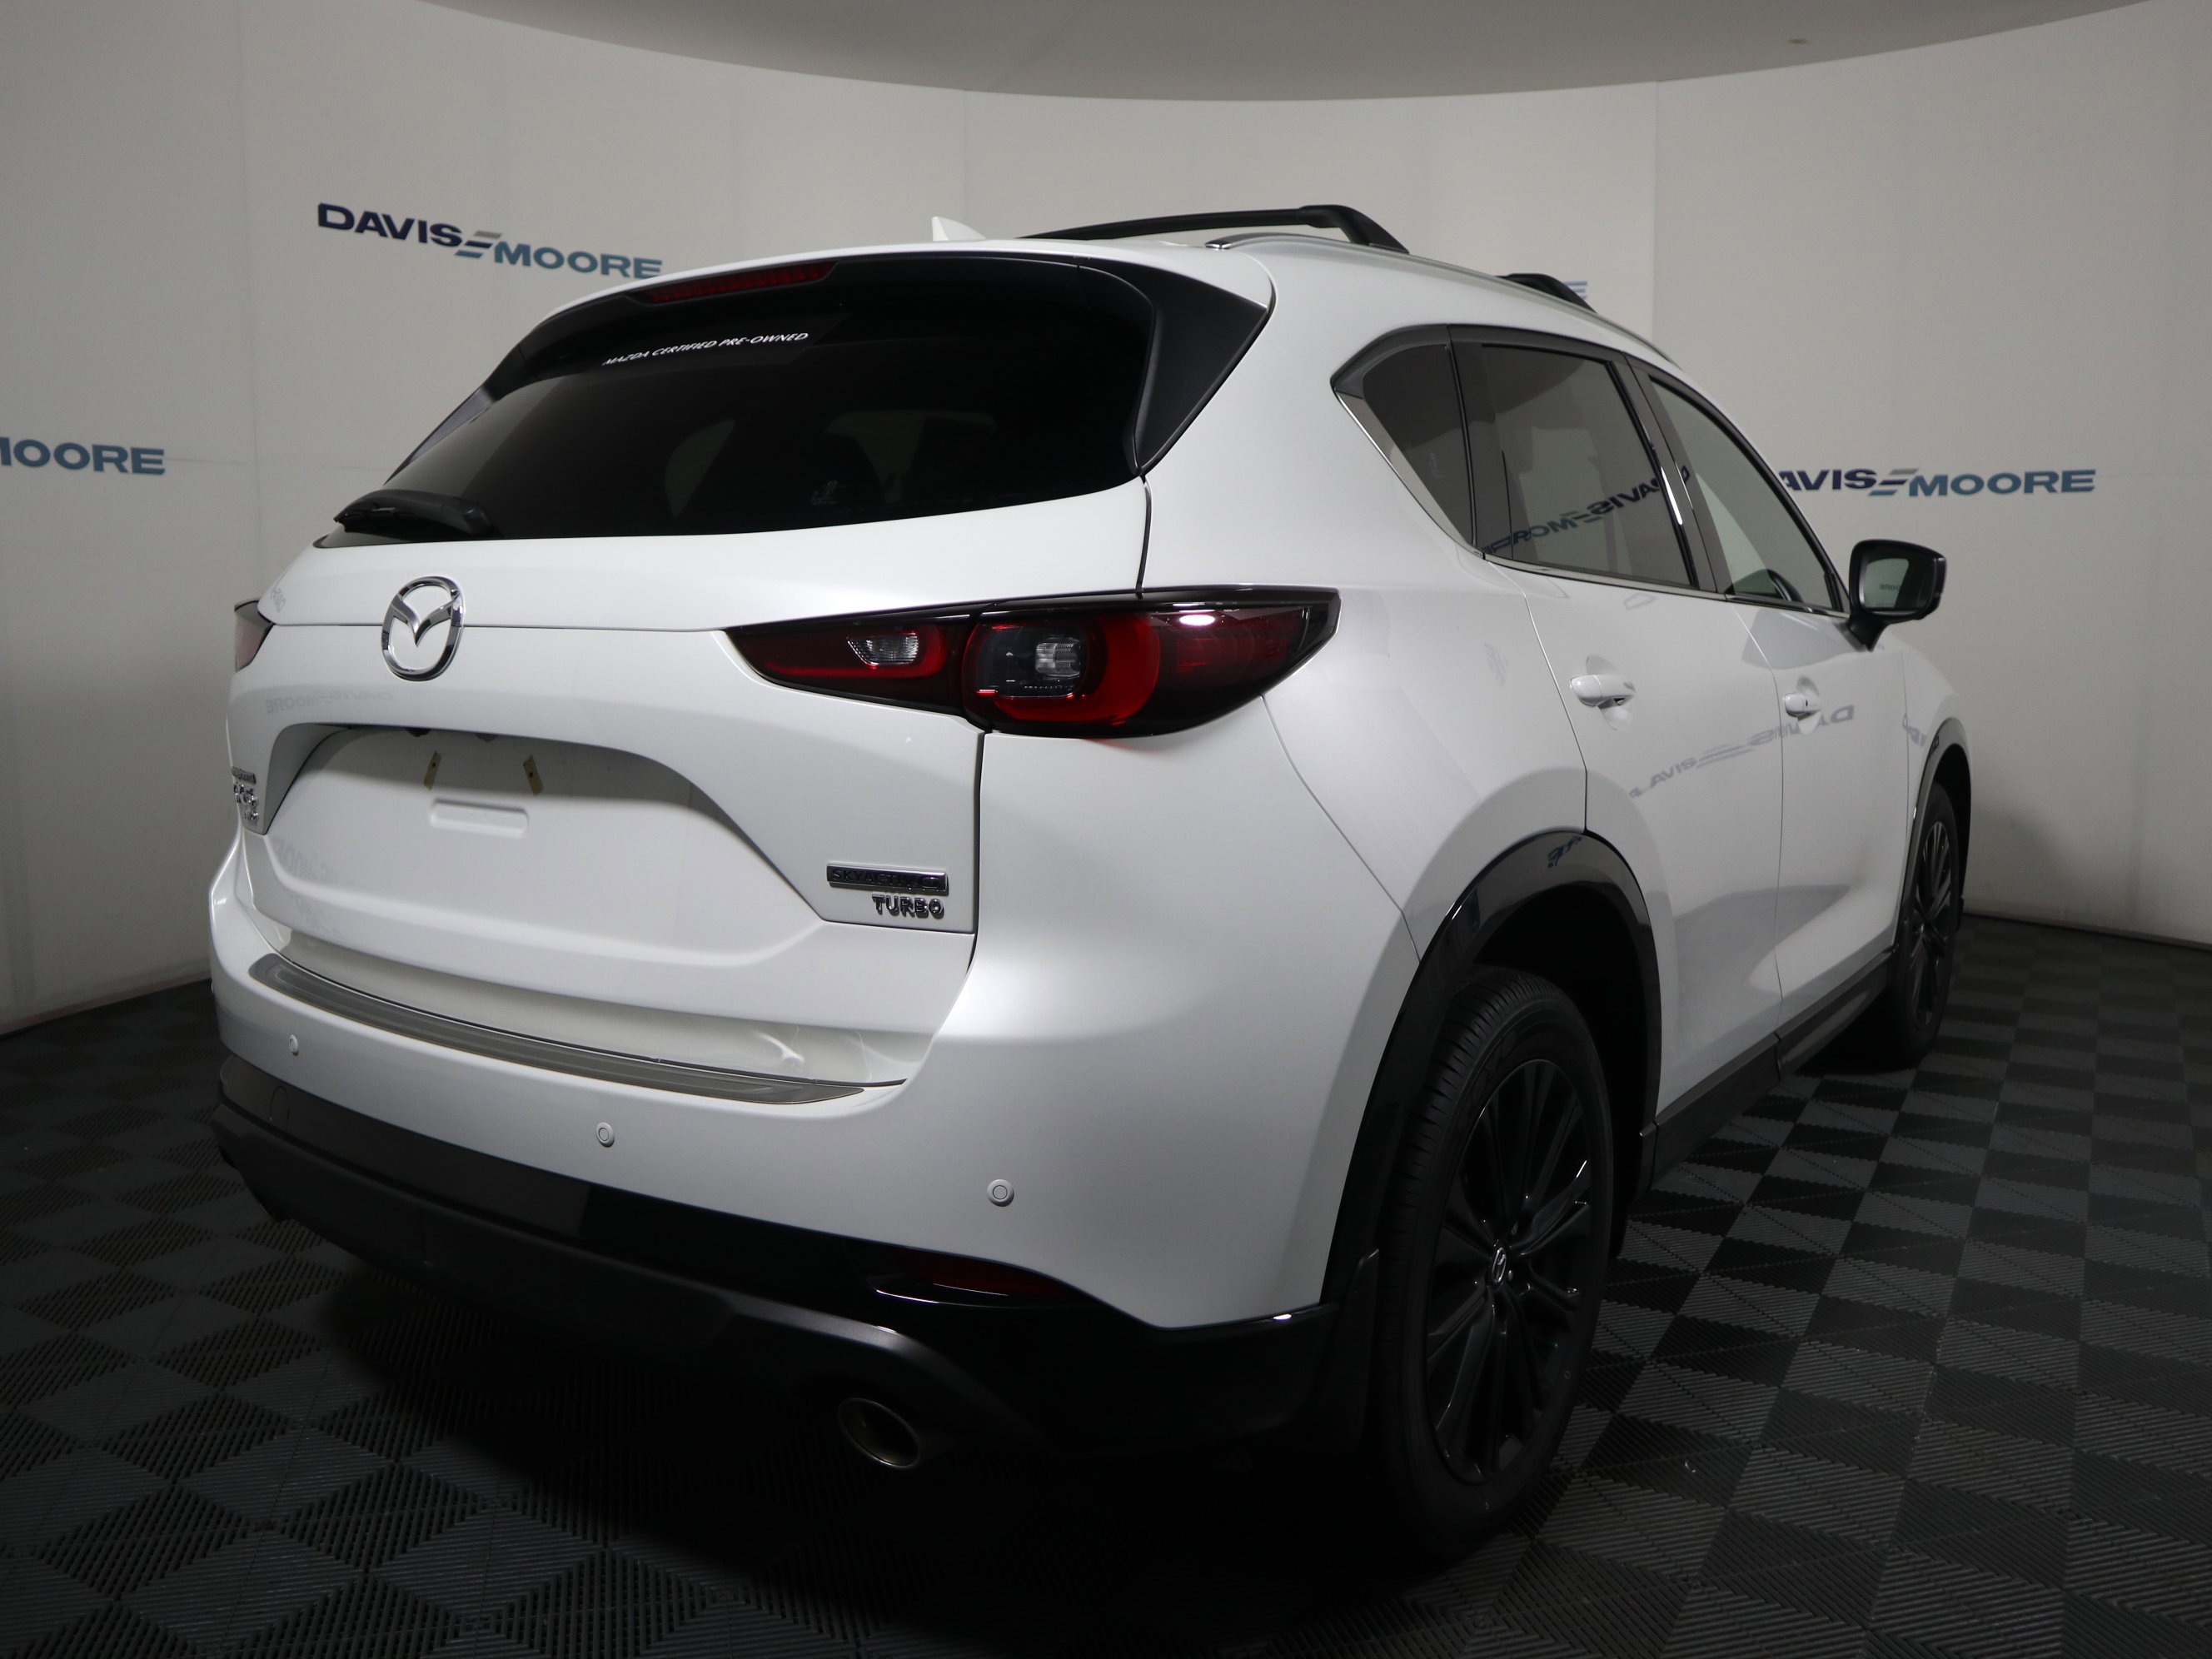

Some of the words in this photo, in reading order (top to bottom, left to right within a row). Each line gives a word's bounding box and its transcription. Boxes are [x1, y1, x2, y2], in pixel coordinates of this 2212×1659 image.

[317, 202, 462, 247] DAVIS
[493, 242, 663, 279] MOORE
[601, 351, 650, 366] MAZDA
[651, 340, 717, 356] CERTIFIED
[718, 333, 809, 346] PRE-OWNED
[1778, 467, 1878, 491] AVIS
[1909, 469, 2096, 497] MOORE
[872, 894, 944, 917] TURBO
